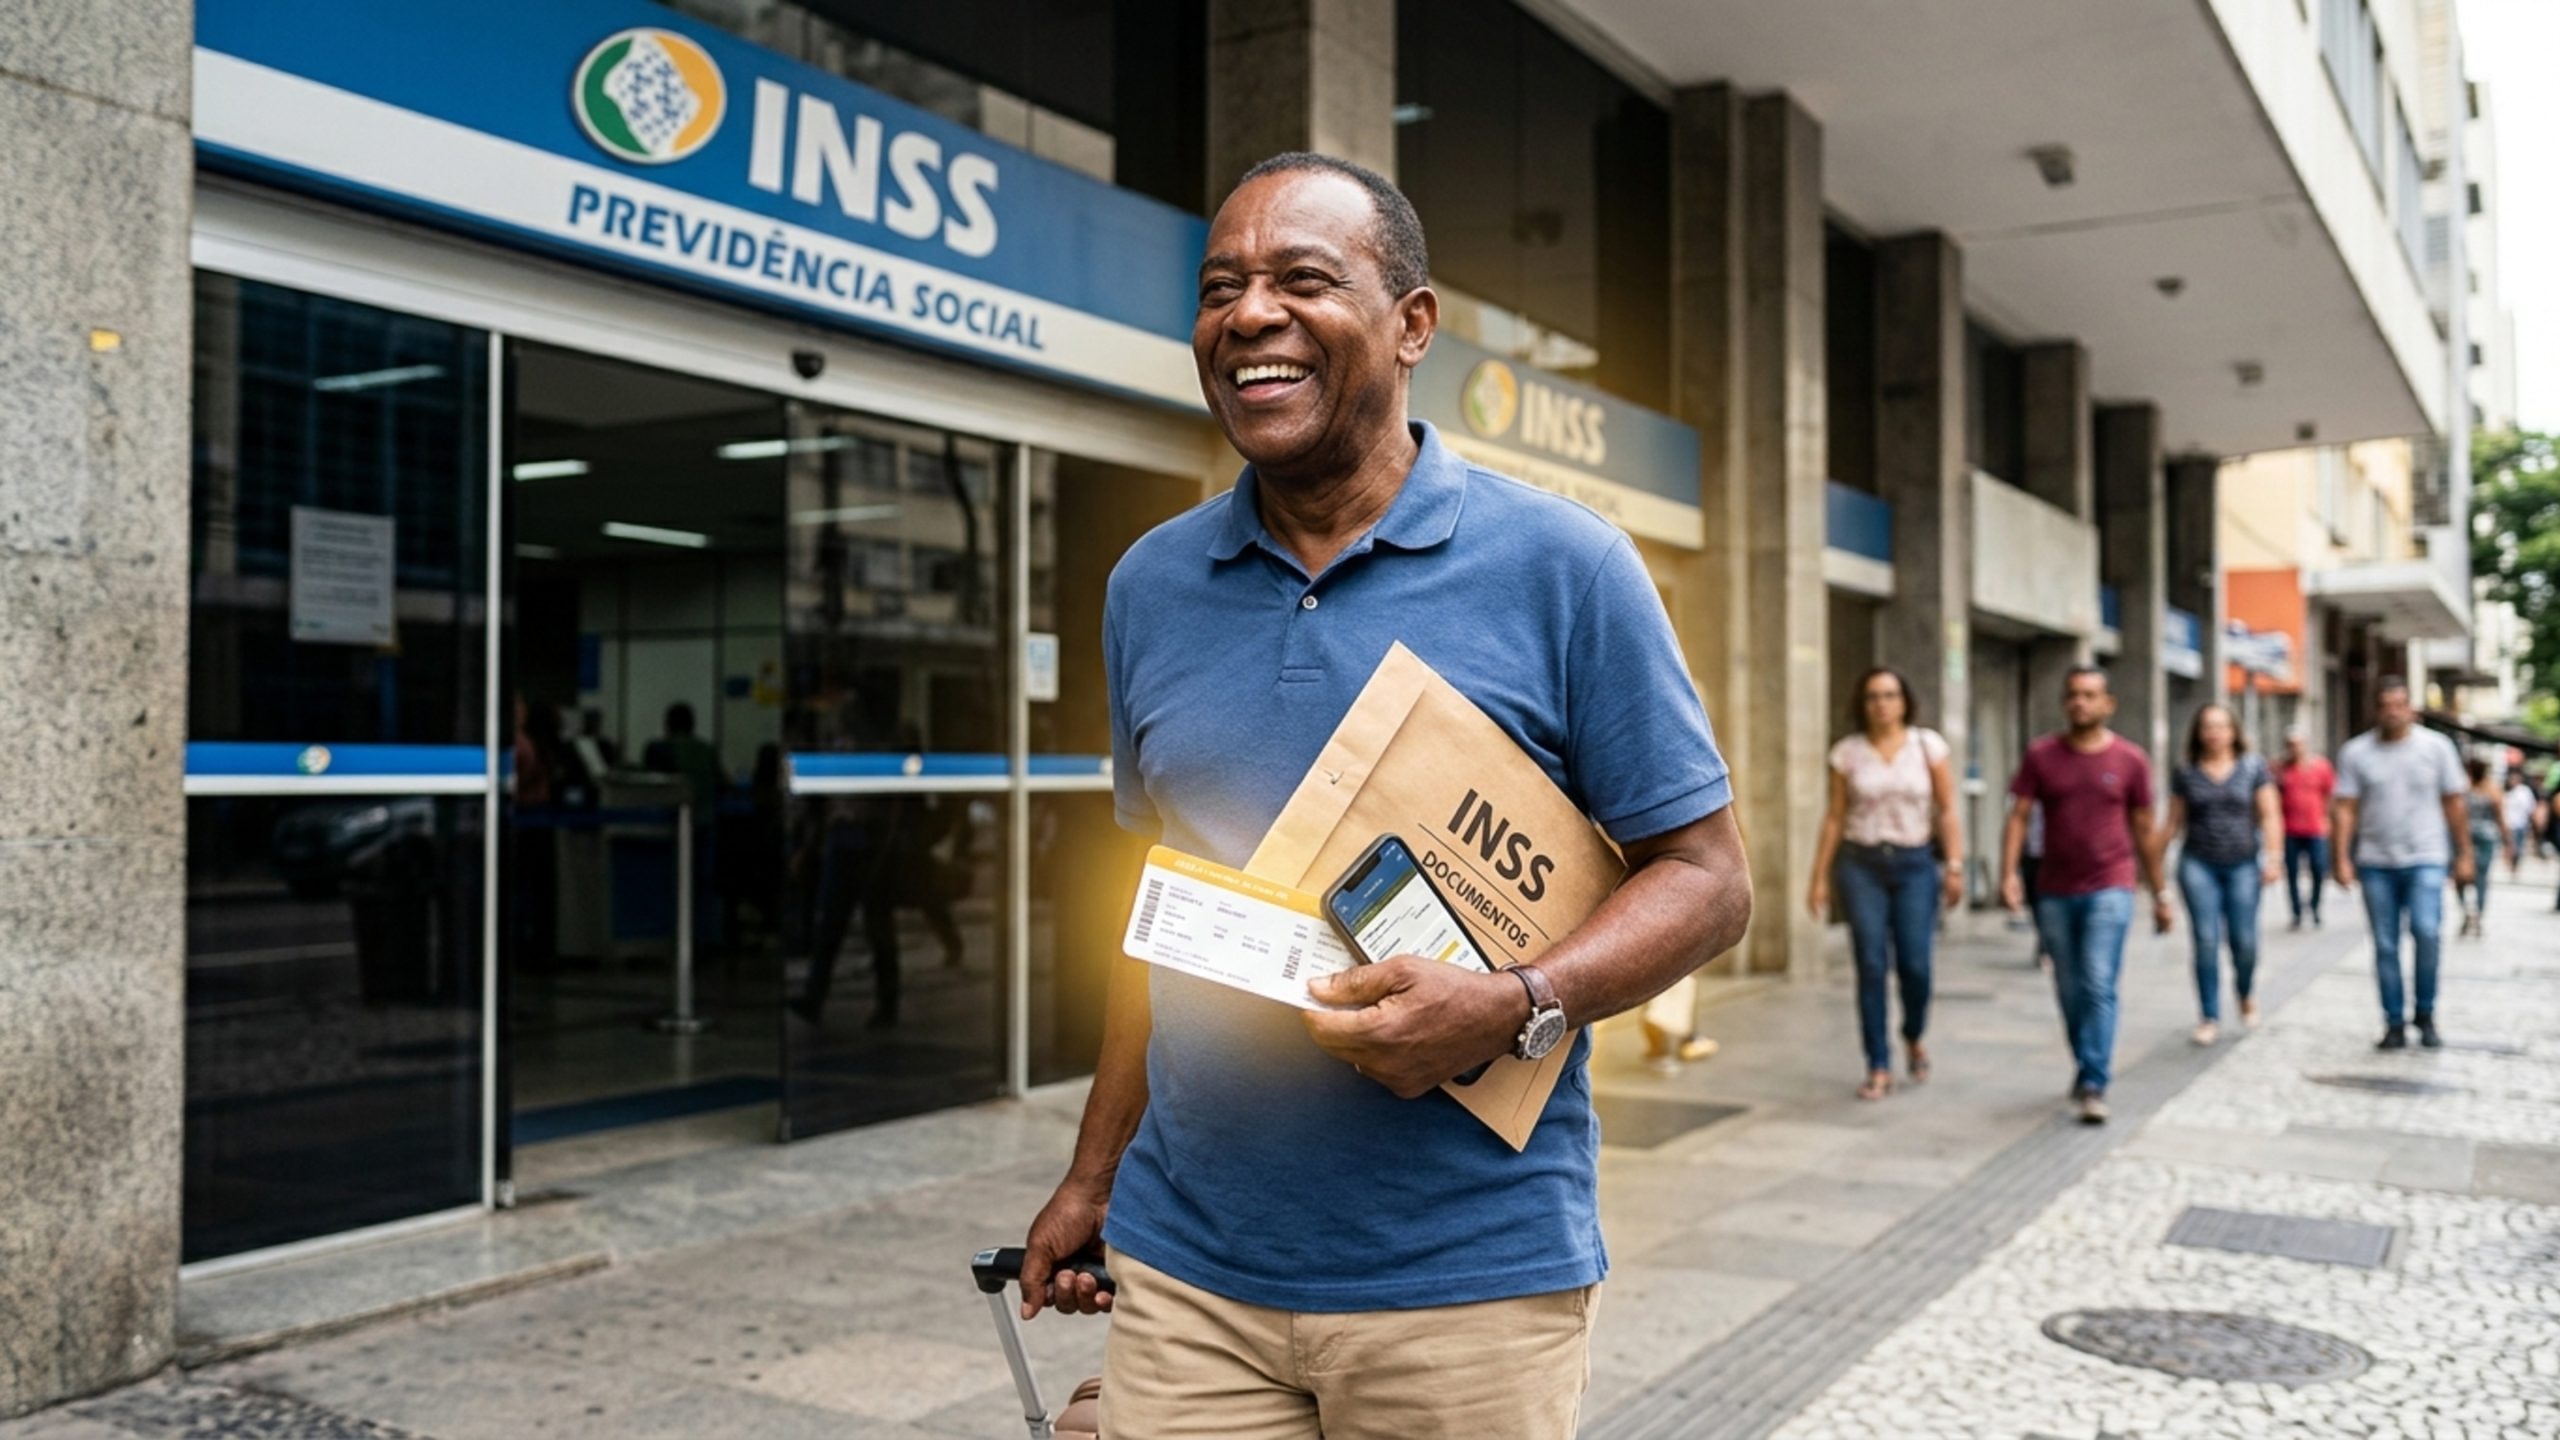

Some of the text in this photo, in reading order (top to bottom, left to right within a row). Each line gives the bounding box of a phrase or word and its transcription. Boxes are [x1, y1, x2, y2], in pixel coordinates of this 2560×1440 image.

[748, 78, 999, 257] INSS
[568, 184, 1045, 351] PREVIDÊNCIA SOCIAL
[1521, 381, 1606, 466] INSS
[1422, 851, 1530, 949] DOCUMENTOS
[1448, 789, 1555, 902] INSS
